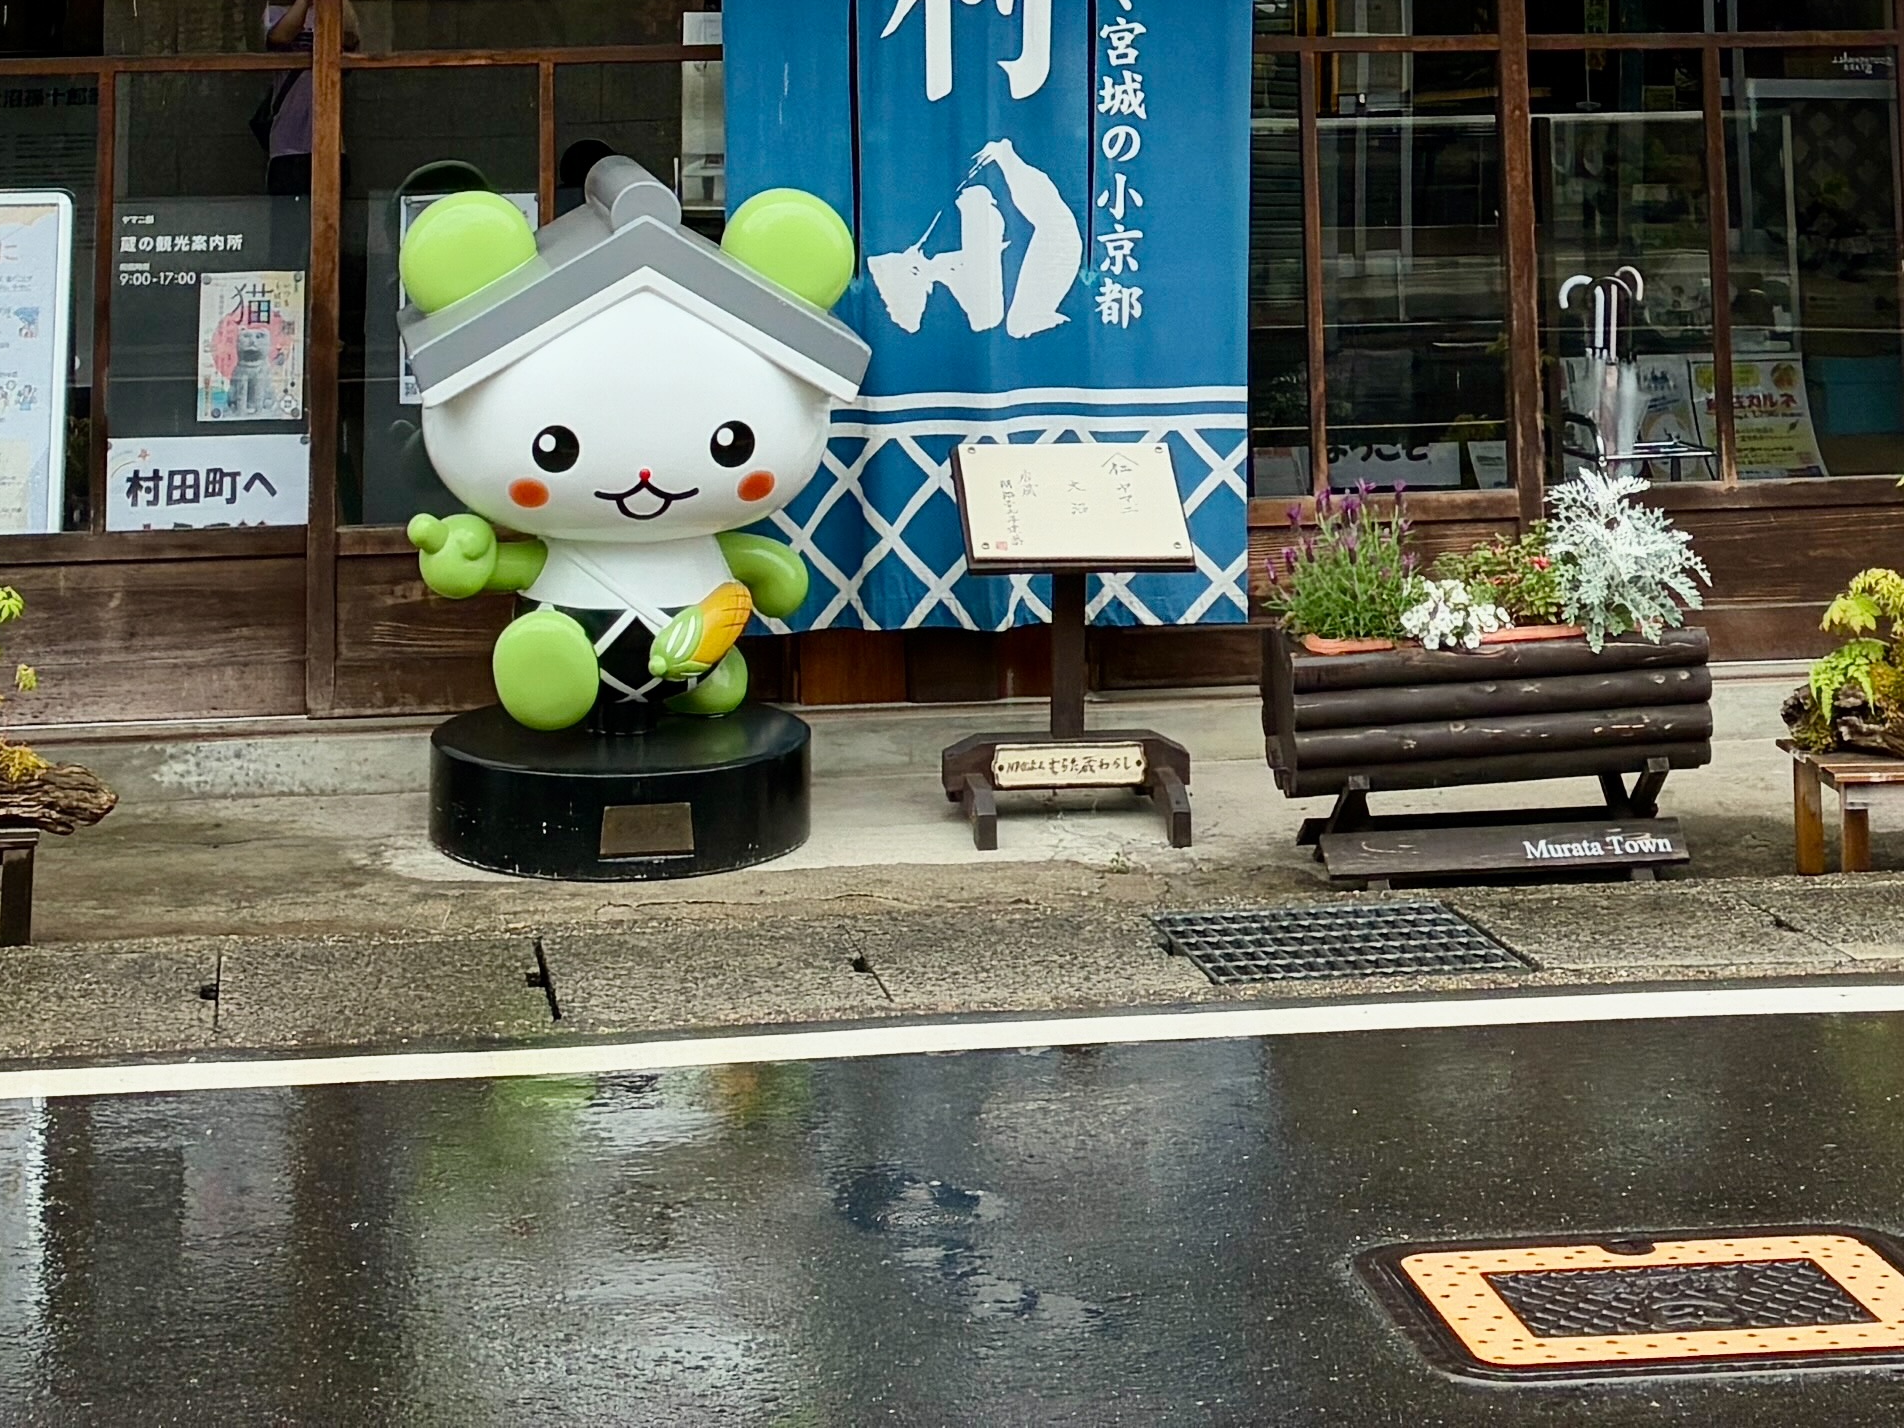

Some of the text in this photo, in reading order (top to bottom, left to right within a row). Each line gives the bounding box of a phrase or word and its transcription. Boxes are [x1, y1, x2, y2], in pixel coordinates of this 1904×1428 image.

[120, 234, 243, 252] 蔵の観光案内所
[120, 272, 196, 286] 9:00-17:00
[231, 283, 274, 325] 猫
[126, 468, 277, 507] 村田町へ
[1523, 836, 1672, 858] Murata Town
